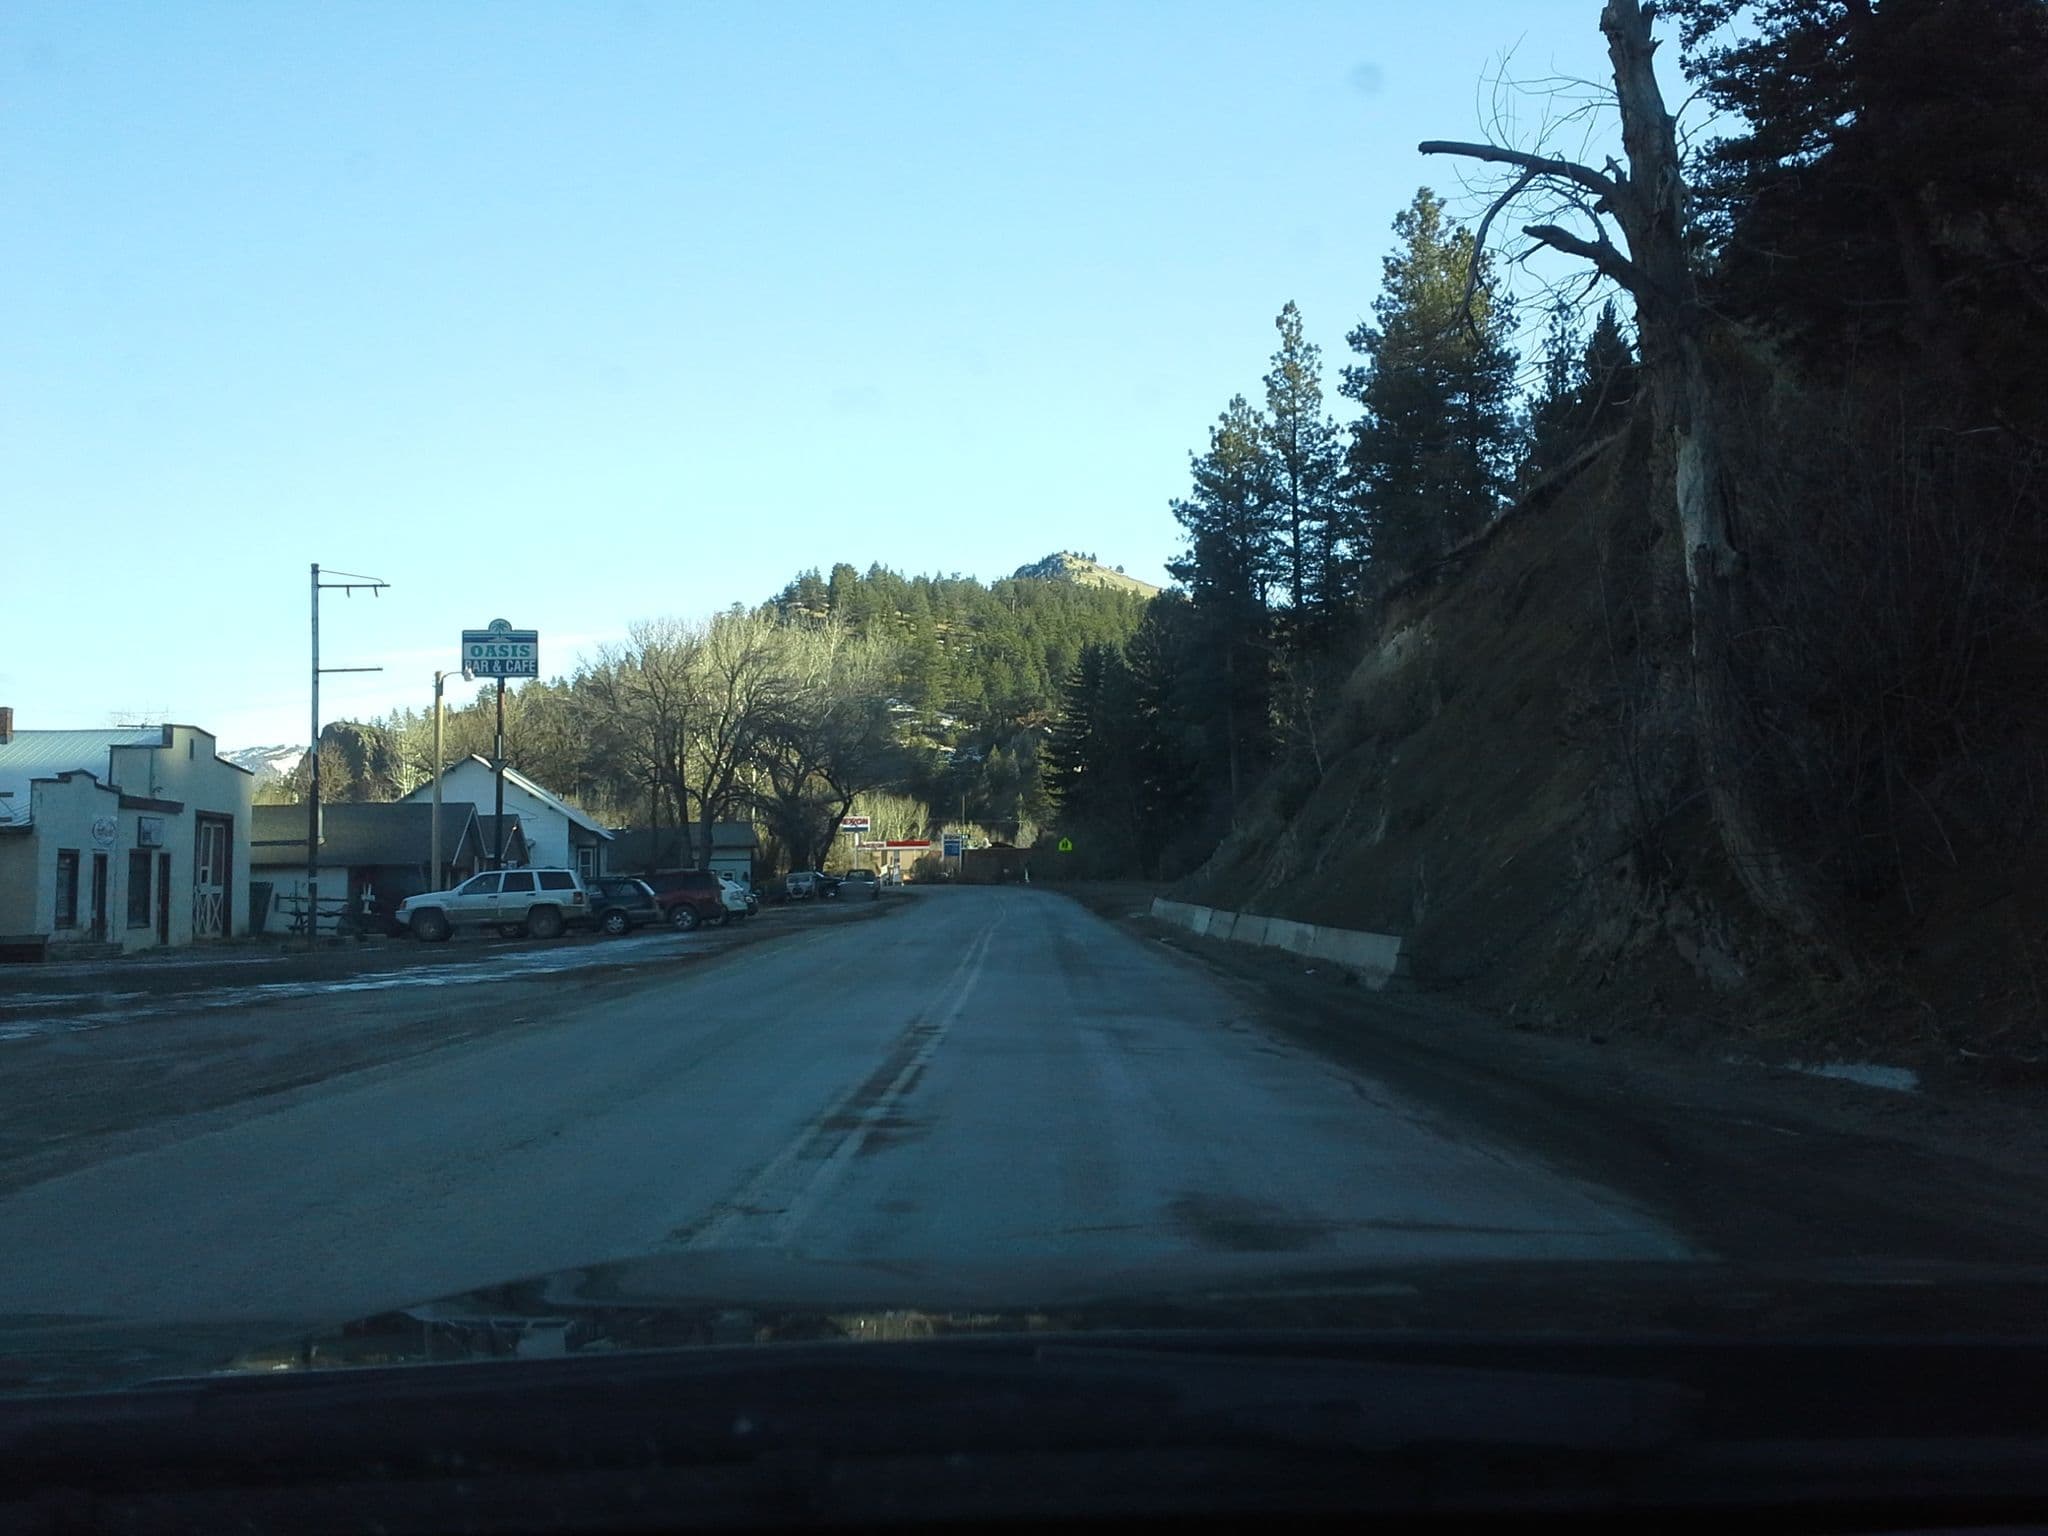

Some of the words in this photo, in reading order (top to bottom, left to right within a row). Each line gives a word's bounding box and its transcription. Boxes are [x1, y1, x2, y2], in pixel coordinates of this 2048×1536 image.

[470, 645, 530, 657] OASIS
[493, 660, 502, 673] &
[506, 660, 536, 673] CAFE
[843, 818, 868, 826] EXXON
